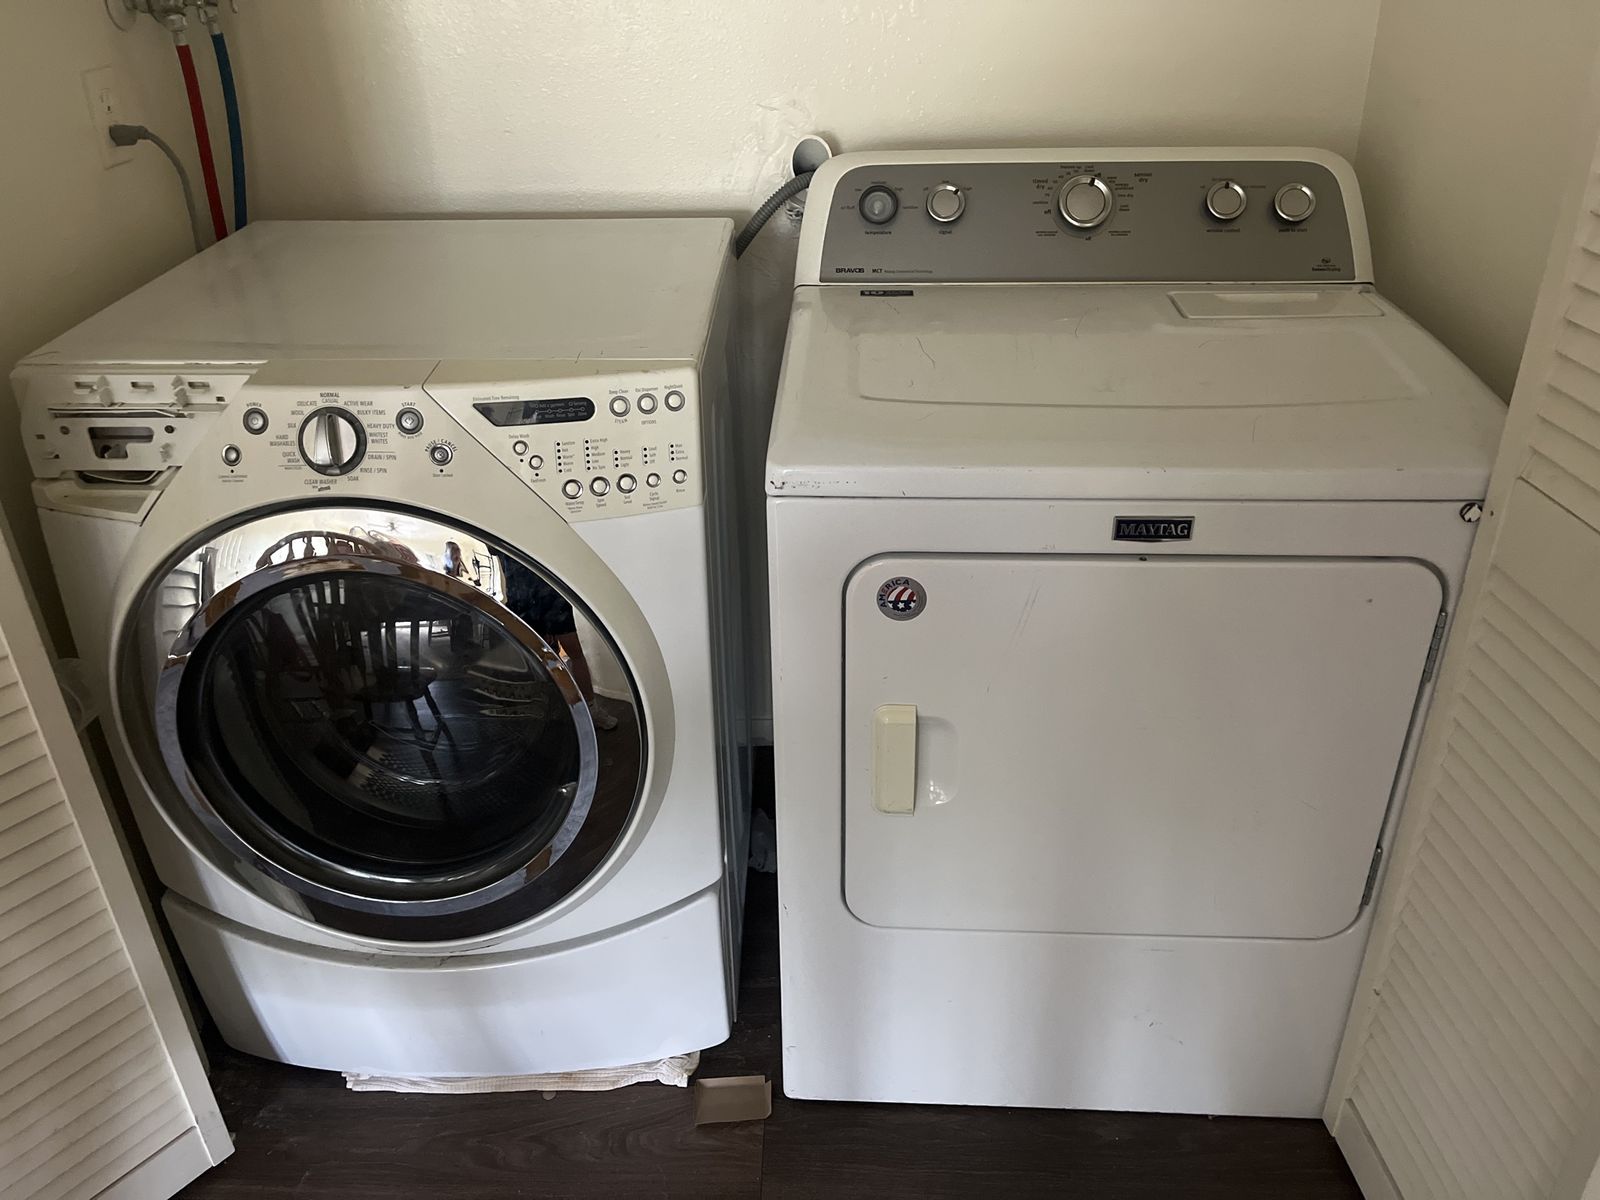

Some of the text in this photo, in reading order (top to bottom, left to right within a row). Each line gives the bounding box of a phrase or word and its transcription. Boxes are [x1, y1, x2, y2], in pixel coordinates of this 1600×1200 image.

[441, 439, 458, 452] CANCEL
[1119, 523, 1189, 537] MAYTAG
[879, 578, 910, 608] AMERICA
